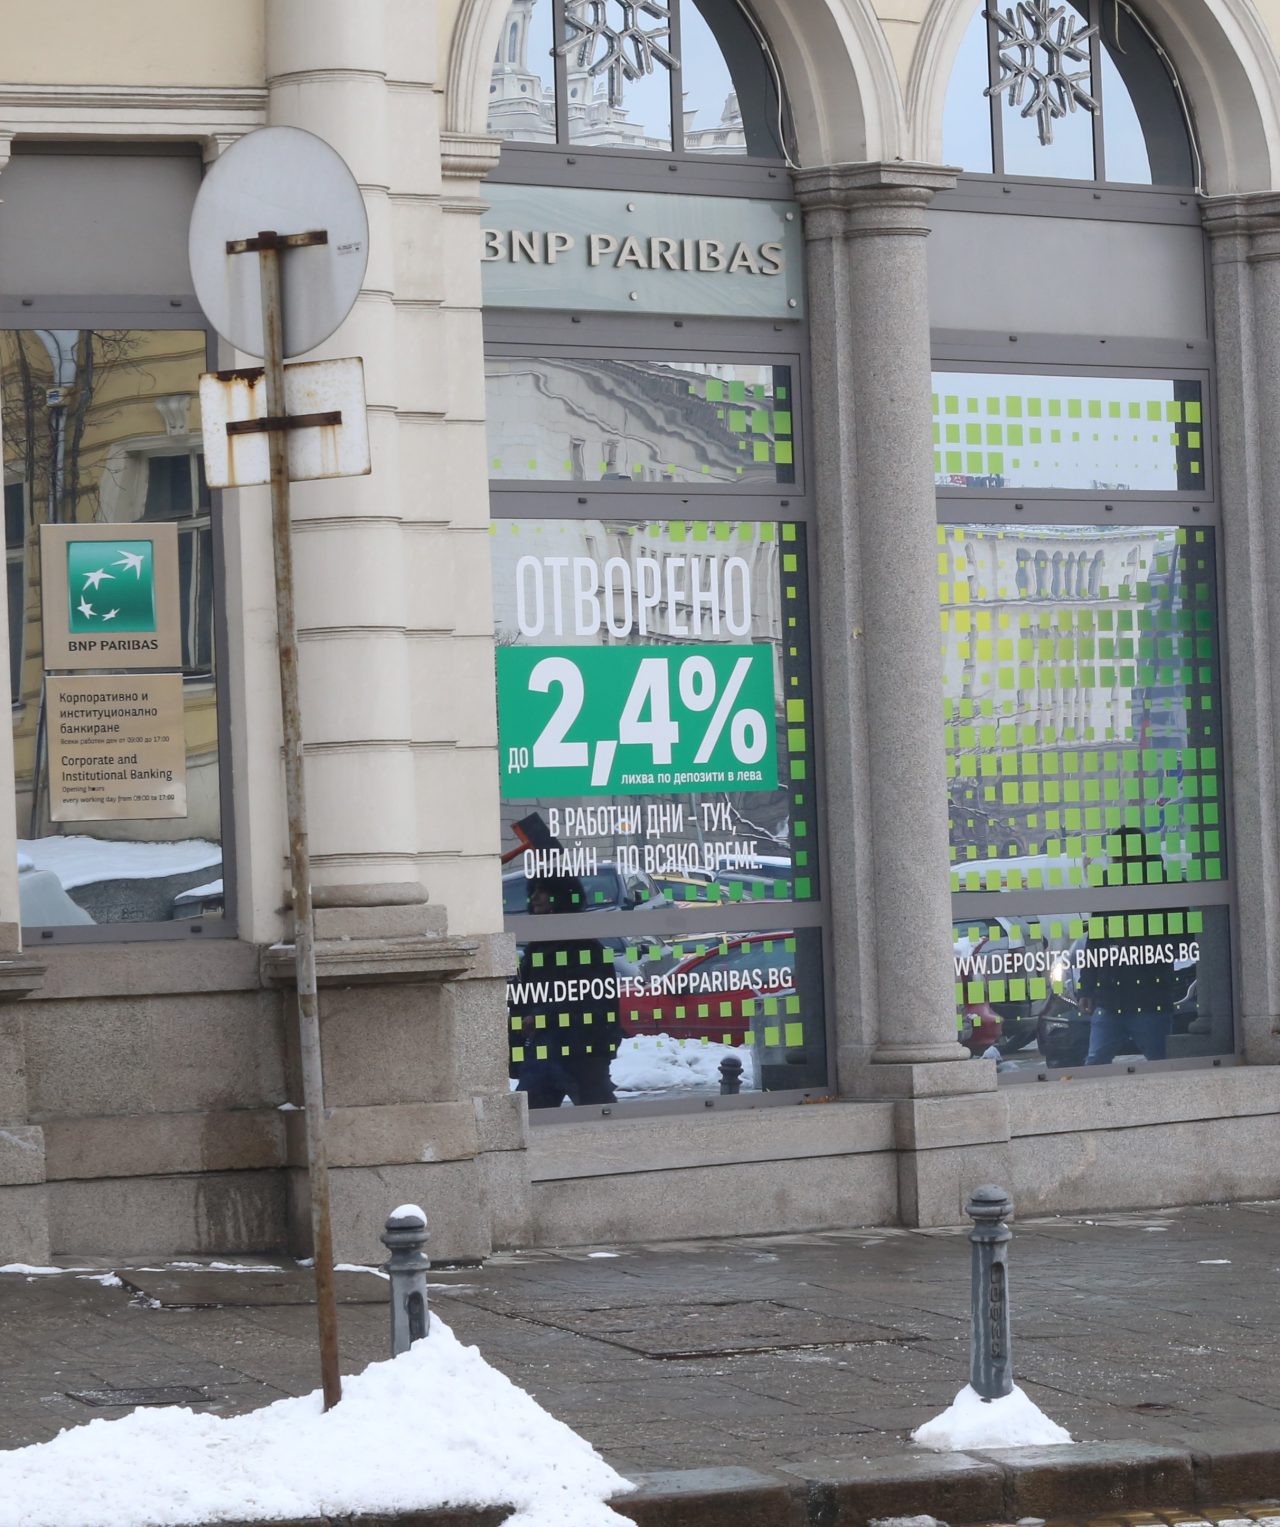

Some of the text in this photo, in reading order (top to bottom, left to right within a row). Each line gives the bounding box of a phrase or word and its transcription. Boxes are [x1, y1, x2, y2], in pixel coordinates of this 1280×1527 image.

[480, 229, 786, 276] BNP PARIBAS
[516, 555, 751, 638] ОТВОРЕНО
[68, 639, 159, 652] BNP PARIBAS
[59, 693, 149, 705] Корпоративно и
[60, 708, 158, 720] институционално
[528, 655, 767, 787] 2,4%
[60, 722, 120, 735] банкиране
[61, 754, 138, 768] Corporate and
[62, 768, 173, 781] Institutional Banking
[621, 770, 762, 785] лихва по депозити в лева
[80, 796, 105, 804] working
[549, 807, 560, 838] В
[565, 805, 642, 837] РАБОТНИ
[646, 803, 684, 840] ДНИ
[701, 802, 737, 836] ТУК,
[524, 841, 598, 879] ОНЛАЙН
[616, 845, 640, 875] ПО
[644, 843, 698, 875] ВСЯКО
[704, 841, 763, 871] ВРЕМЕ.
[953, 941, 1200, 977] WW.DEPOSITS.BNPPARIBAS.BG
[506, 966, 793, 1005] WW.DEPOSITS.BNPPARIBAS.BG
